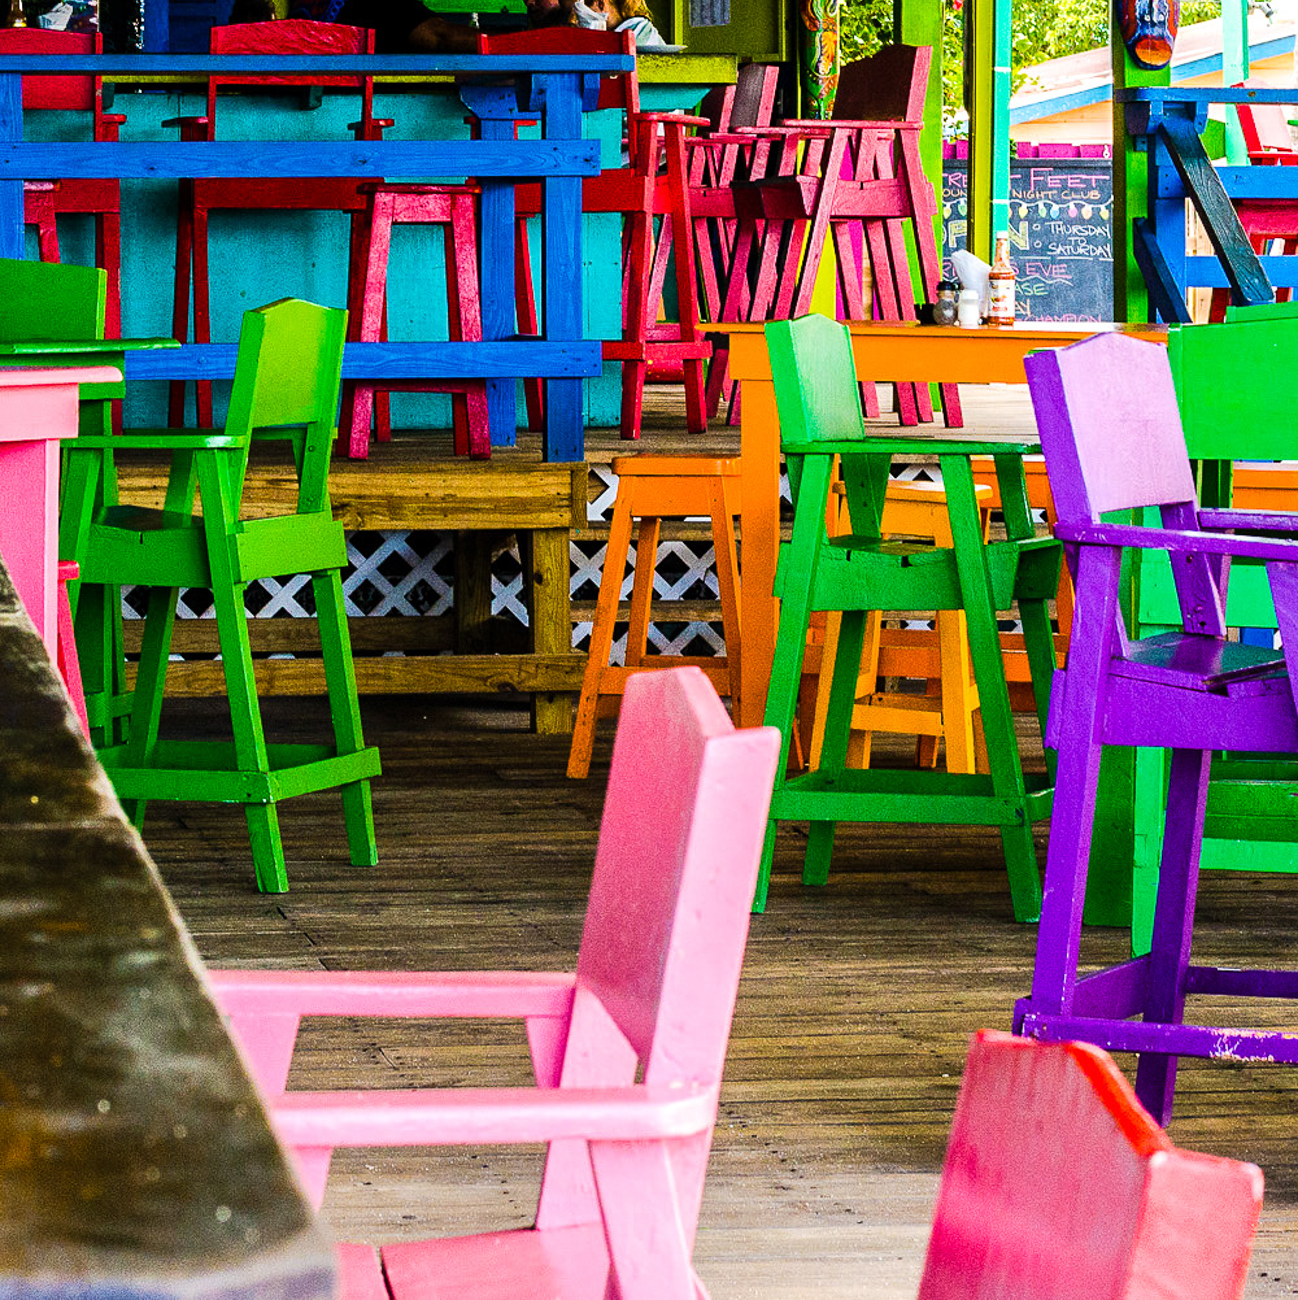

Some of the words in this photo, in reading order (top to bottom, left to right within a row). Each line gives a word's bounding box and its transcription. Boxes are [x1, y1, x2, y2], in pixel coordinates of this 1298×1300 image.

[1030, 167, 1110, 192] FEET
[1012, 189, 1056, 200] NIGHT
[1061, 190, 1101, 200] CLUB
[1045, 221, 1111, 239] THURSDAY
[1047, 242, 1113, 258] SATURDAY
[1026, 262, 1072, 279] EVE
